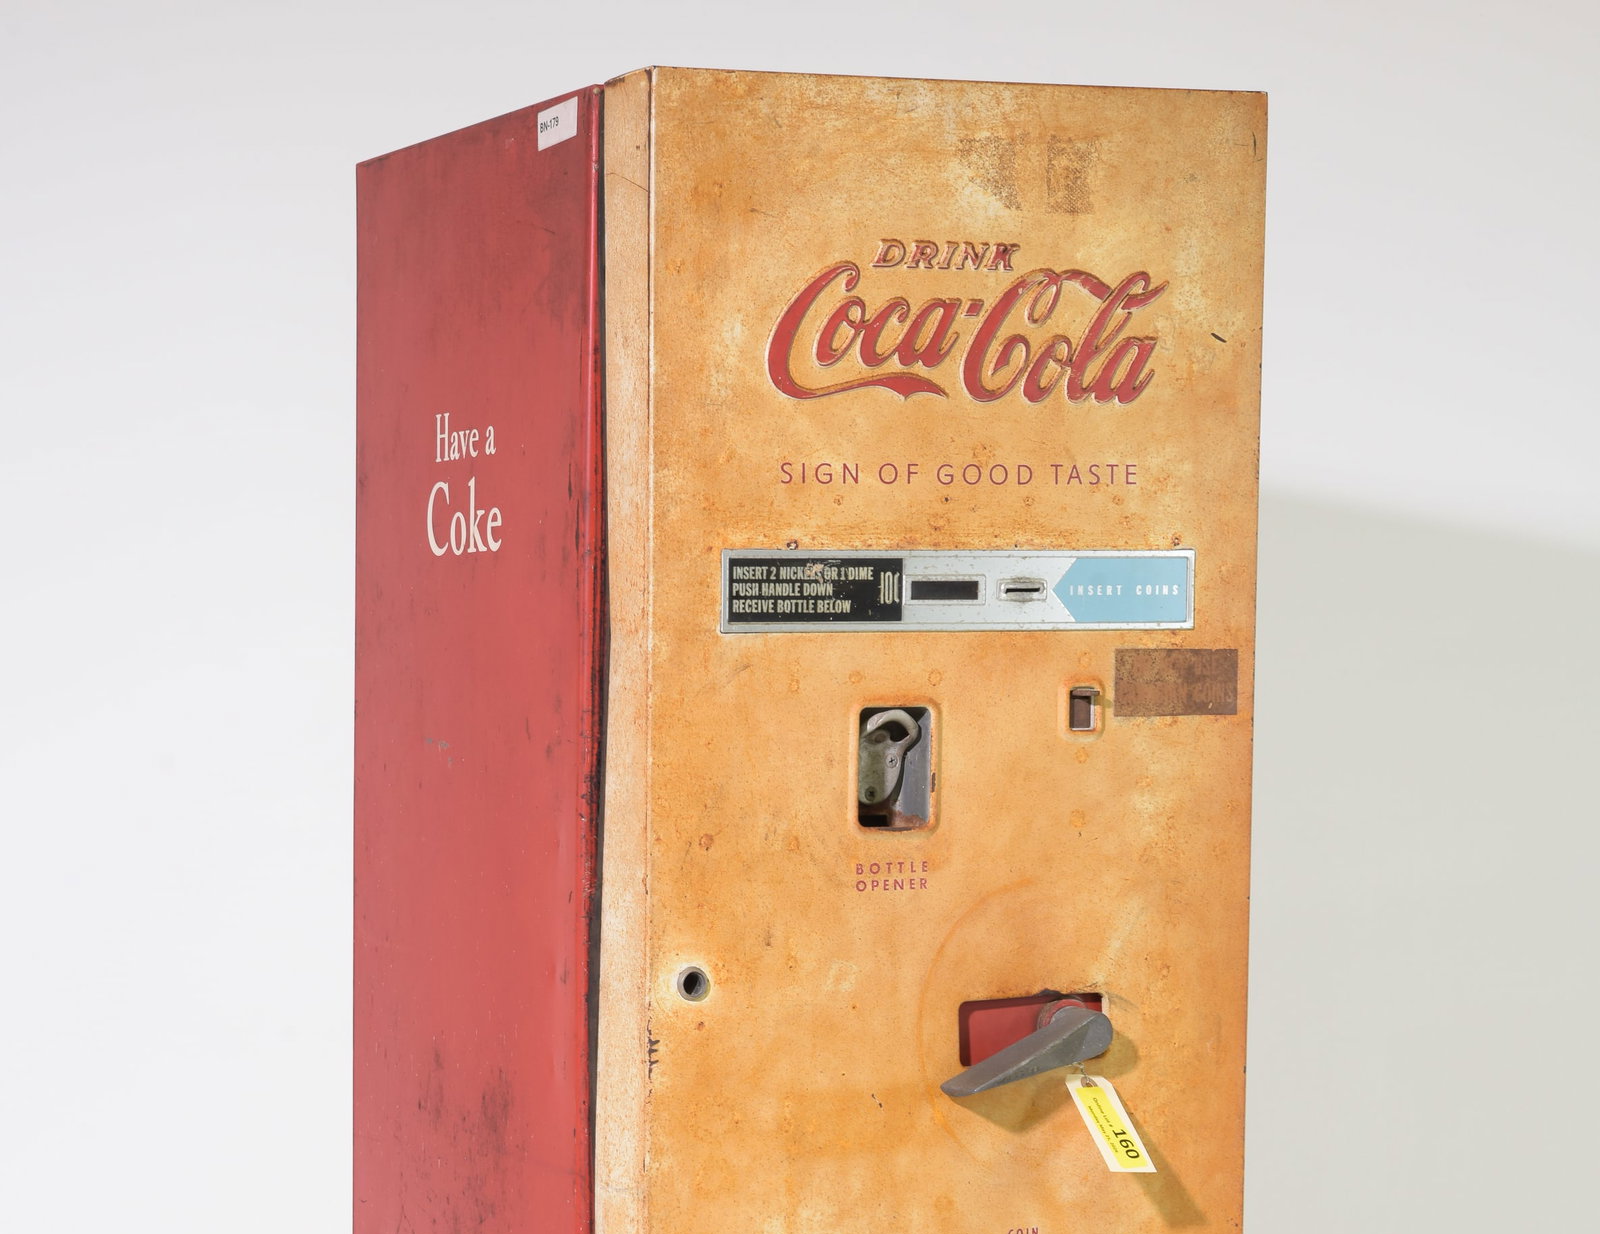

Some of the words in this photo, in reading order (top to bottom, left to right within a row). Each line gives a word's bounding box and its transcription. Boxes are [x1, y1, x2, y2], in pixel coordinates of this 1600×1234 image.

[872, 237, 1021, 271] DRINK
[765, 260, 1170, 405] Coca-Cola
[435, 412, 480, 463] Have
[485, 425, 496, 455] a
[780, 462, 860, 485] SIGN
[878, 463, 919, 485] OF
[936, 463, 1034, 485] GOOD
[1050, 464, 1138, 486] TASTE
[427, 476, 502, 557] Coke
[732, 566, 768, 580] INSERT
[770, 566, 776, 580] 2
[824, 567, 839, 580] OR
[840, 567, 845, 580] 1
[849, 567, 874, 580] DIME
[732, 583, 759, 597] PUSH
[762, 583, 800, 596] HANDLE
[803, 583, 833, 596] DOWN
[1070, 585, 1123, 596] INSERT
[1136, 584, 1179, 596] COINS
[732, 599, 775, 613] RECEIVE
[777, 599, 814, 613] BOTTLE
[817, 599, 851, 613] BELOW
[856, 861, 928, 875] BOTTLE
[856, 878, 928, 892] OPENER
[1112, 1129, 1140, 1159] 160
